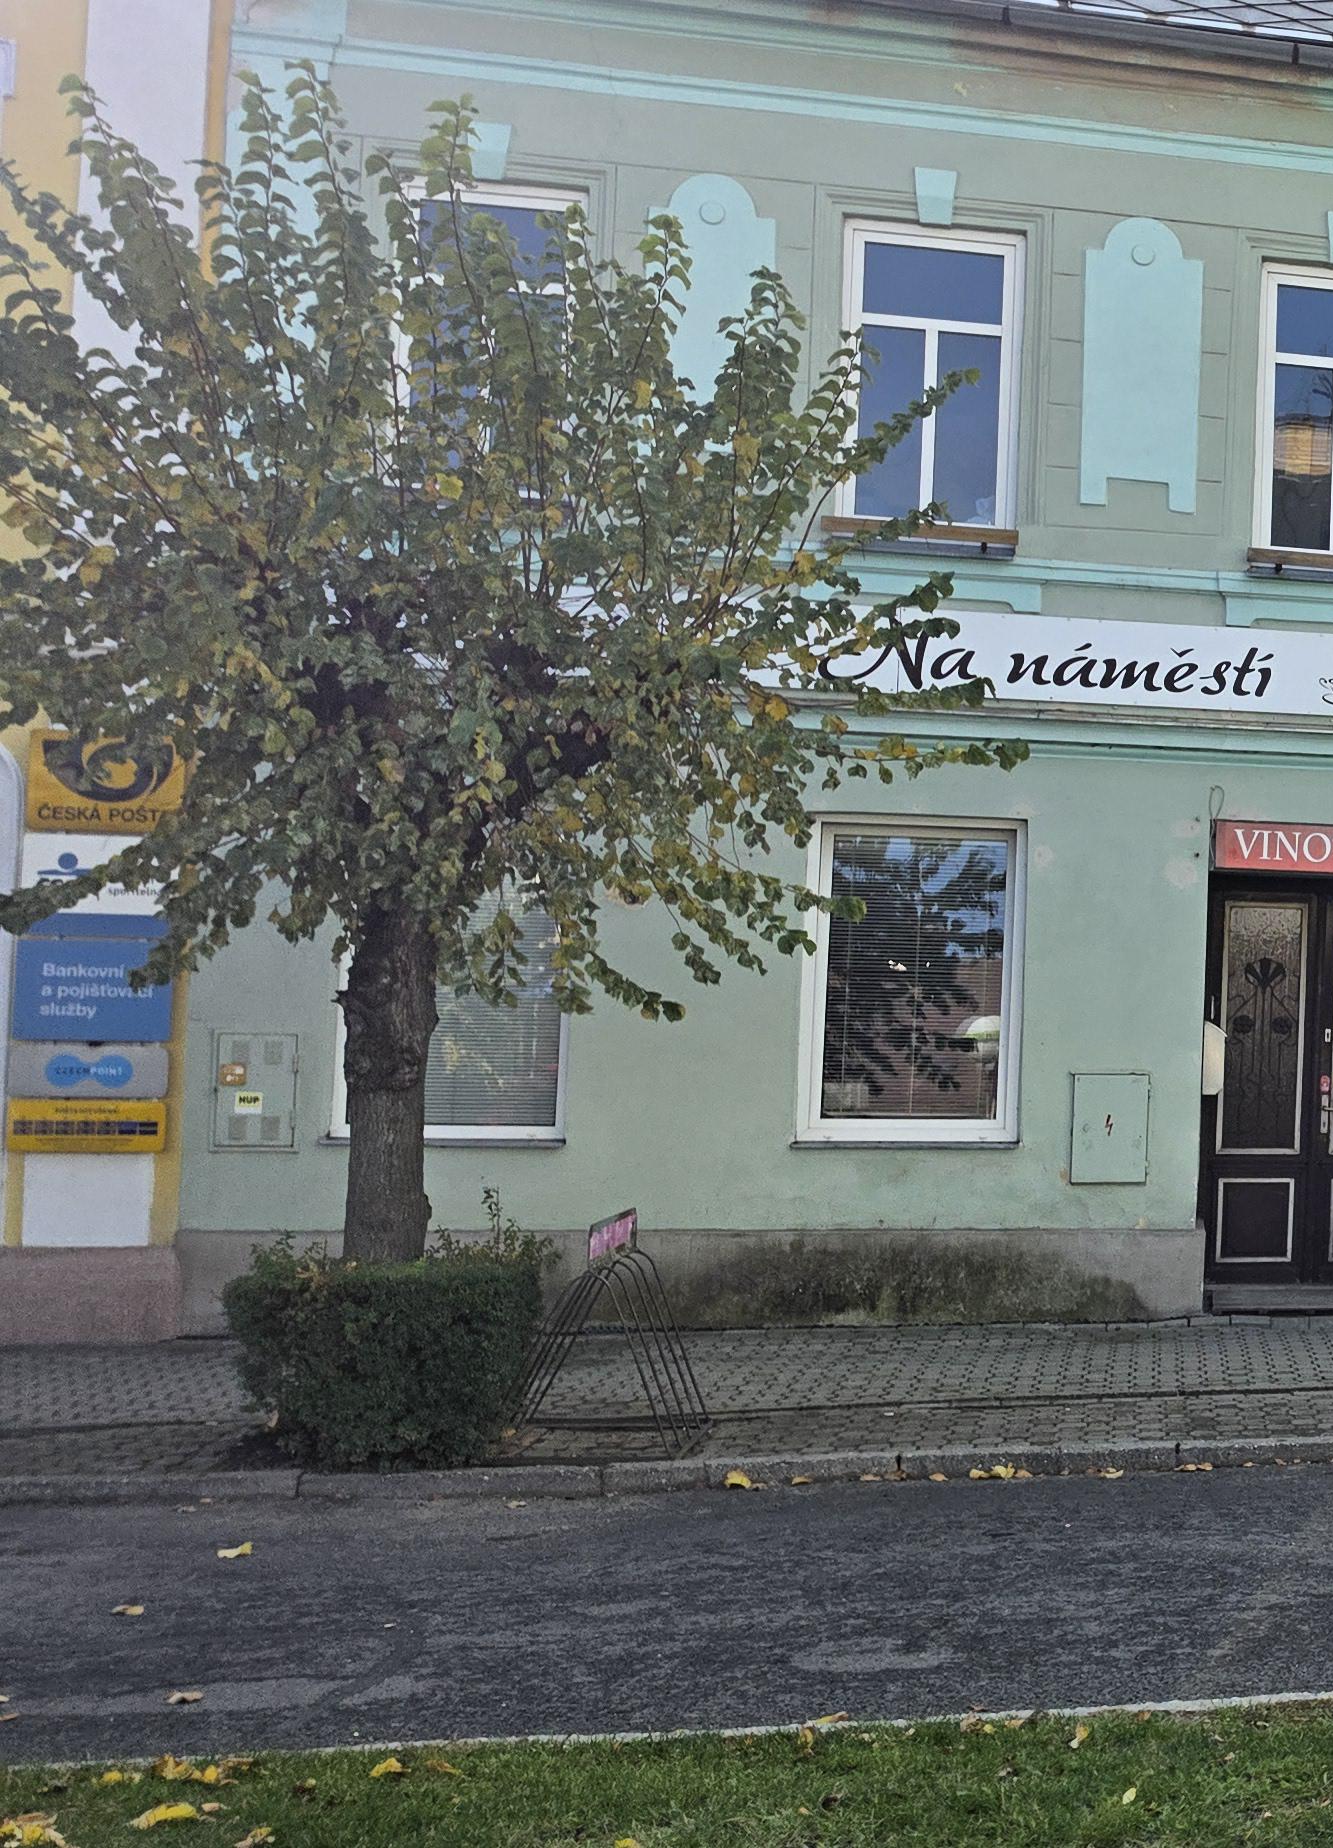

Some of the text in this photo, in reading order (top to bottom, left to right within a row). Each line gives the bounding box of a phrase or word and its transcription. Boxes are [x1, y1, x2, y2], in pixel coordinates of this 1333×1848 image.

[818, 630, 1275, 697] Na náměstí
[37, 804, 160, 822] ČESKÁ POŠT
[42, 963, 125, 979] Bankovní
[41, 985, 52, 997] a
[39, 1002, 97, 1019] služby
